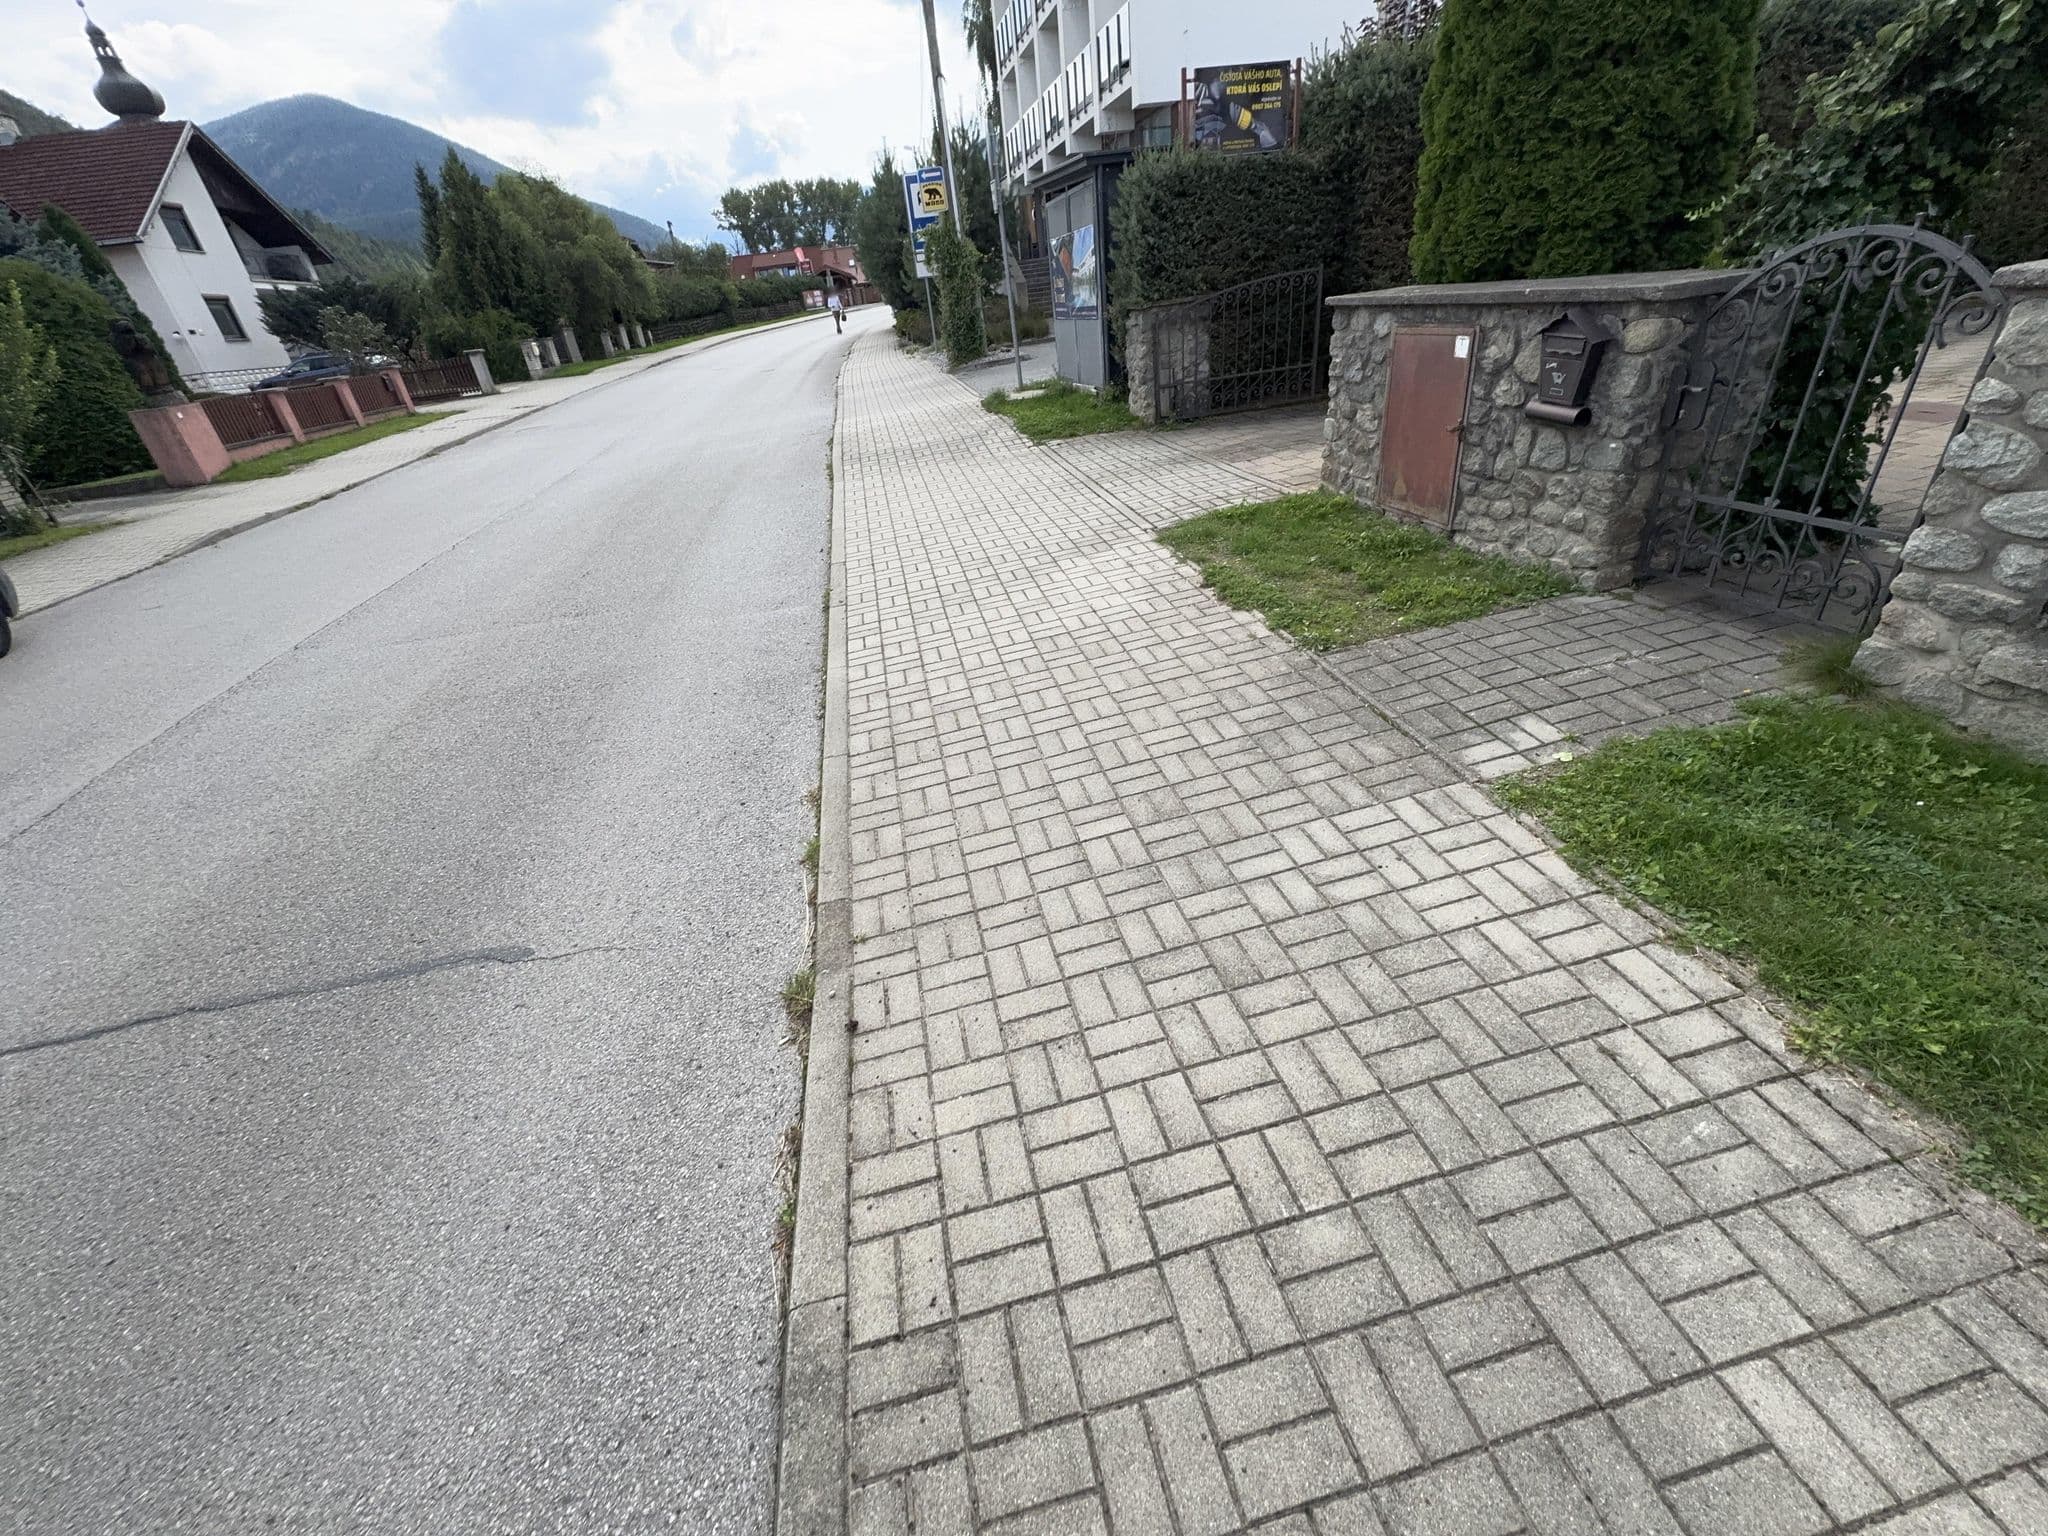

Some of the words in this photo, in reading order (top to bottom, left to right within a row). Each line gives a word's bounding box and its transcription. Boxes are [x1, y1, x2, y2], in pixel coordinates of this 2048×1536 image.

[1244, 69, 1264, 80] VÁŠHO
[1226, 83, 1247, 95] KTORÁ
[1248, 81, 1261, 93] VÁS
[1261, 79, 1283, 92] OSLEPÍ
